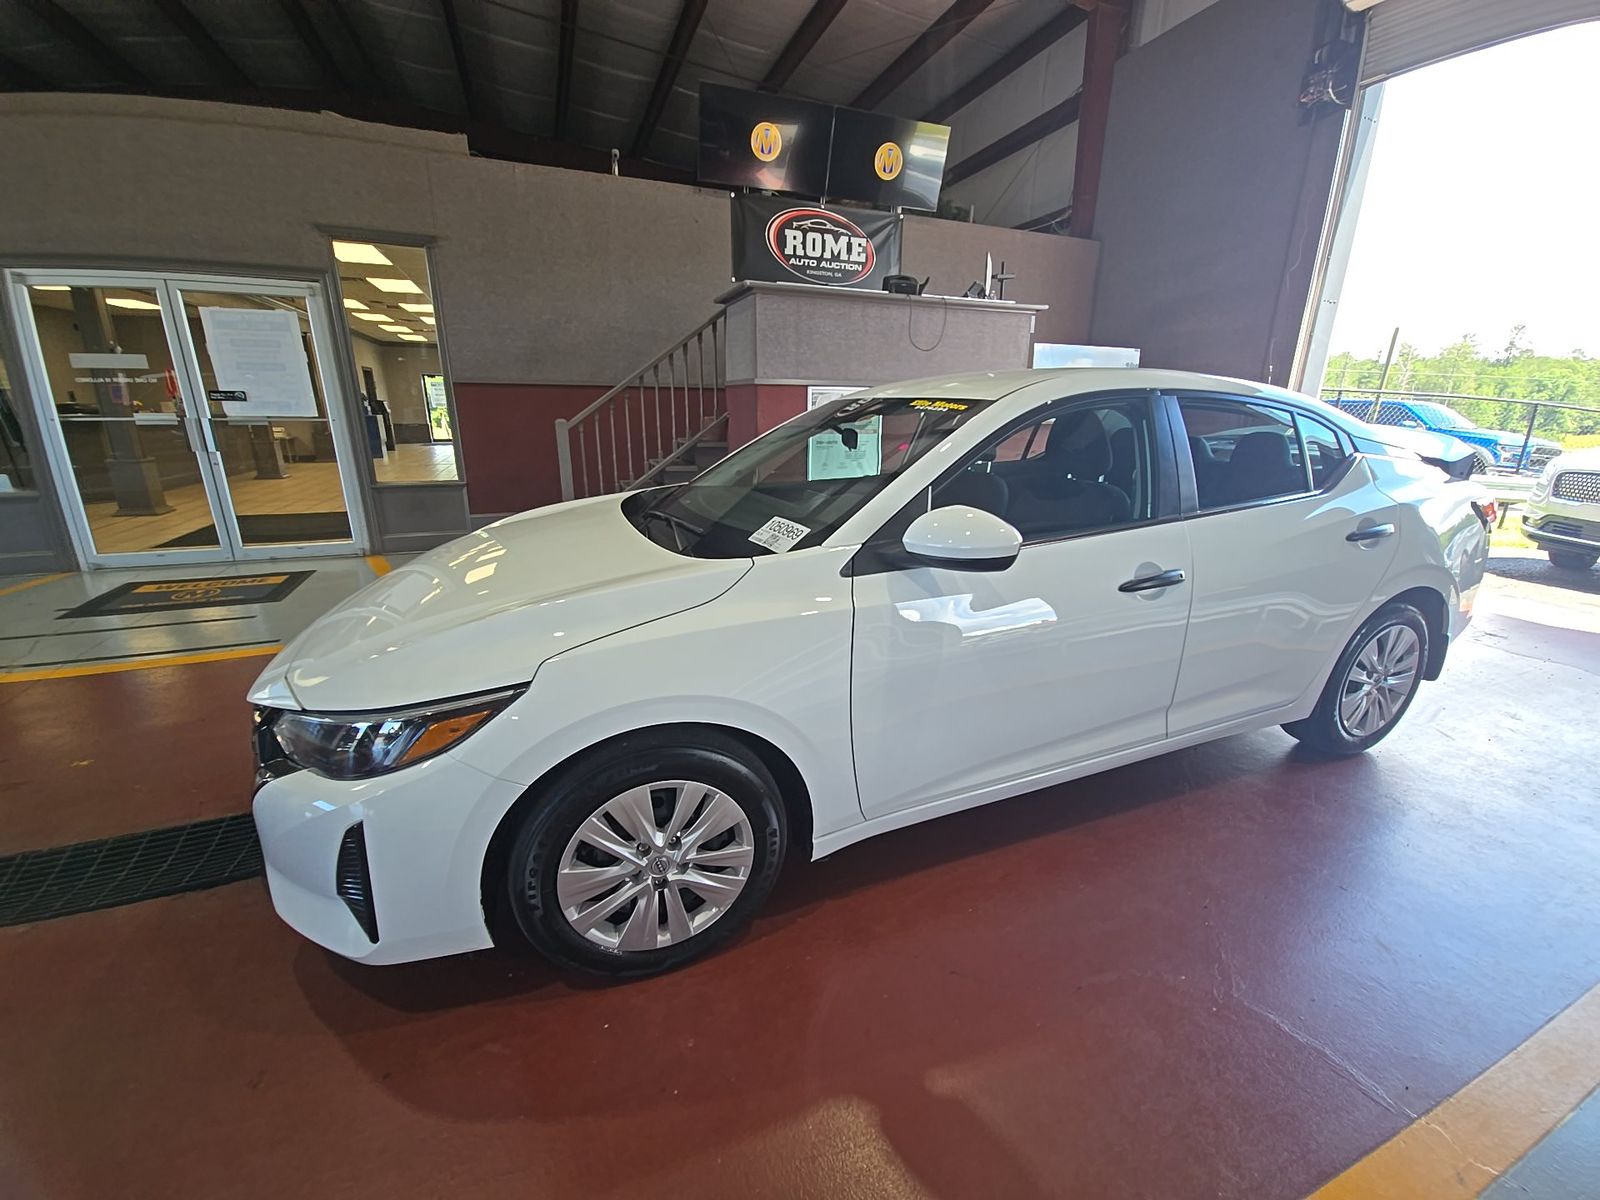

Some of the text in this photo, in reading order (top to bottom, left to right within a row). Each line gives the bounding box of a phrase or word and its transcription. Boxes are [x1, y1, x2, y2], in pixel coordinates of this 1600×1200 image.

[784, 228, 867, 262] ROME
[789, 257, 863, 271] AUTO AUCTION
[766, 520, 804, 540] 1050969
[156, 578, 267, 591] WELCOME
